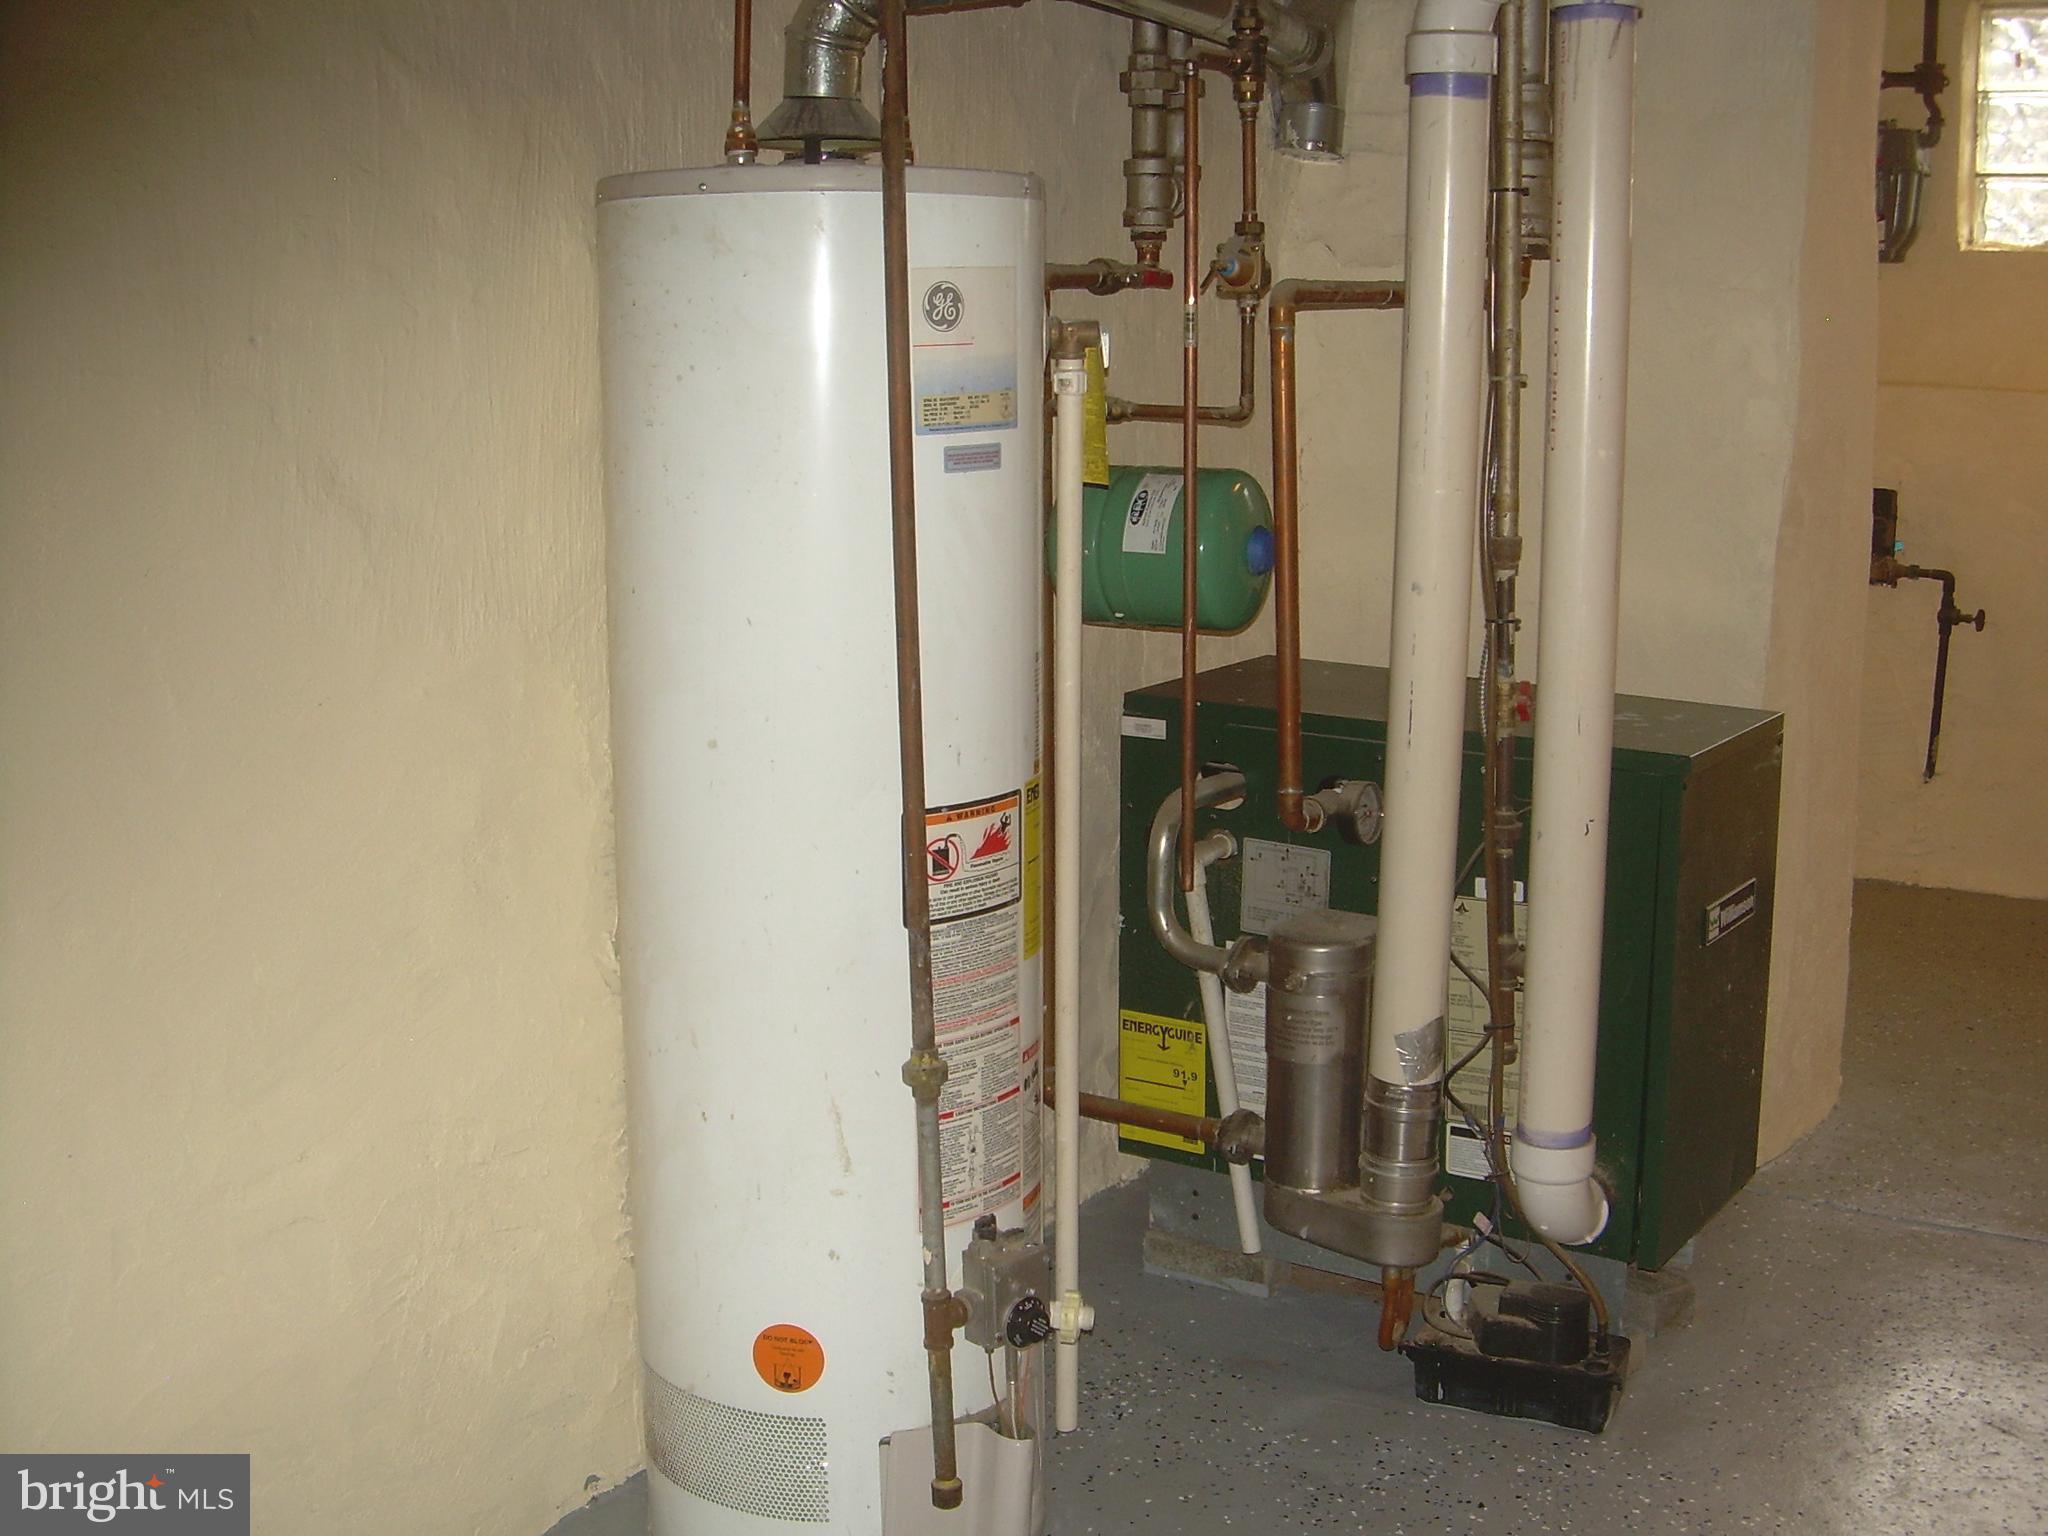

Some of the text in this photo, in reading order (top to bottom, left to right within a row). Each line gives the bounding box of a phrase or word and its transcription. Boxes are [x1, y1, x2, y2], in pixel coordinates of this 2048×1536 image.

[956, 805, 998, 820] WARNING
[1122, 1018, 1203, 1044] ENERGYGUIDE
[1173, 1068, 1198, 1082] 91.9
